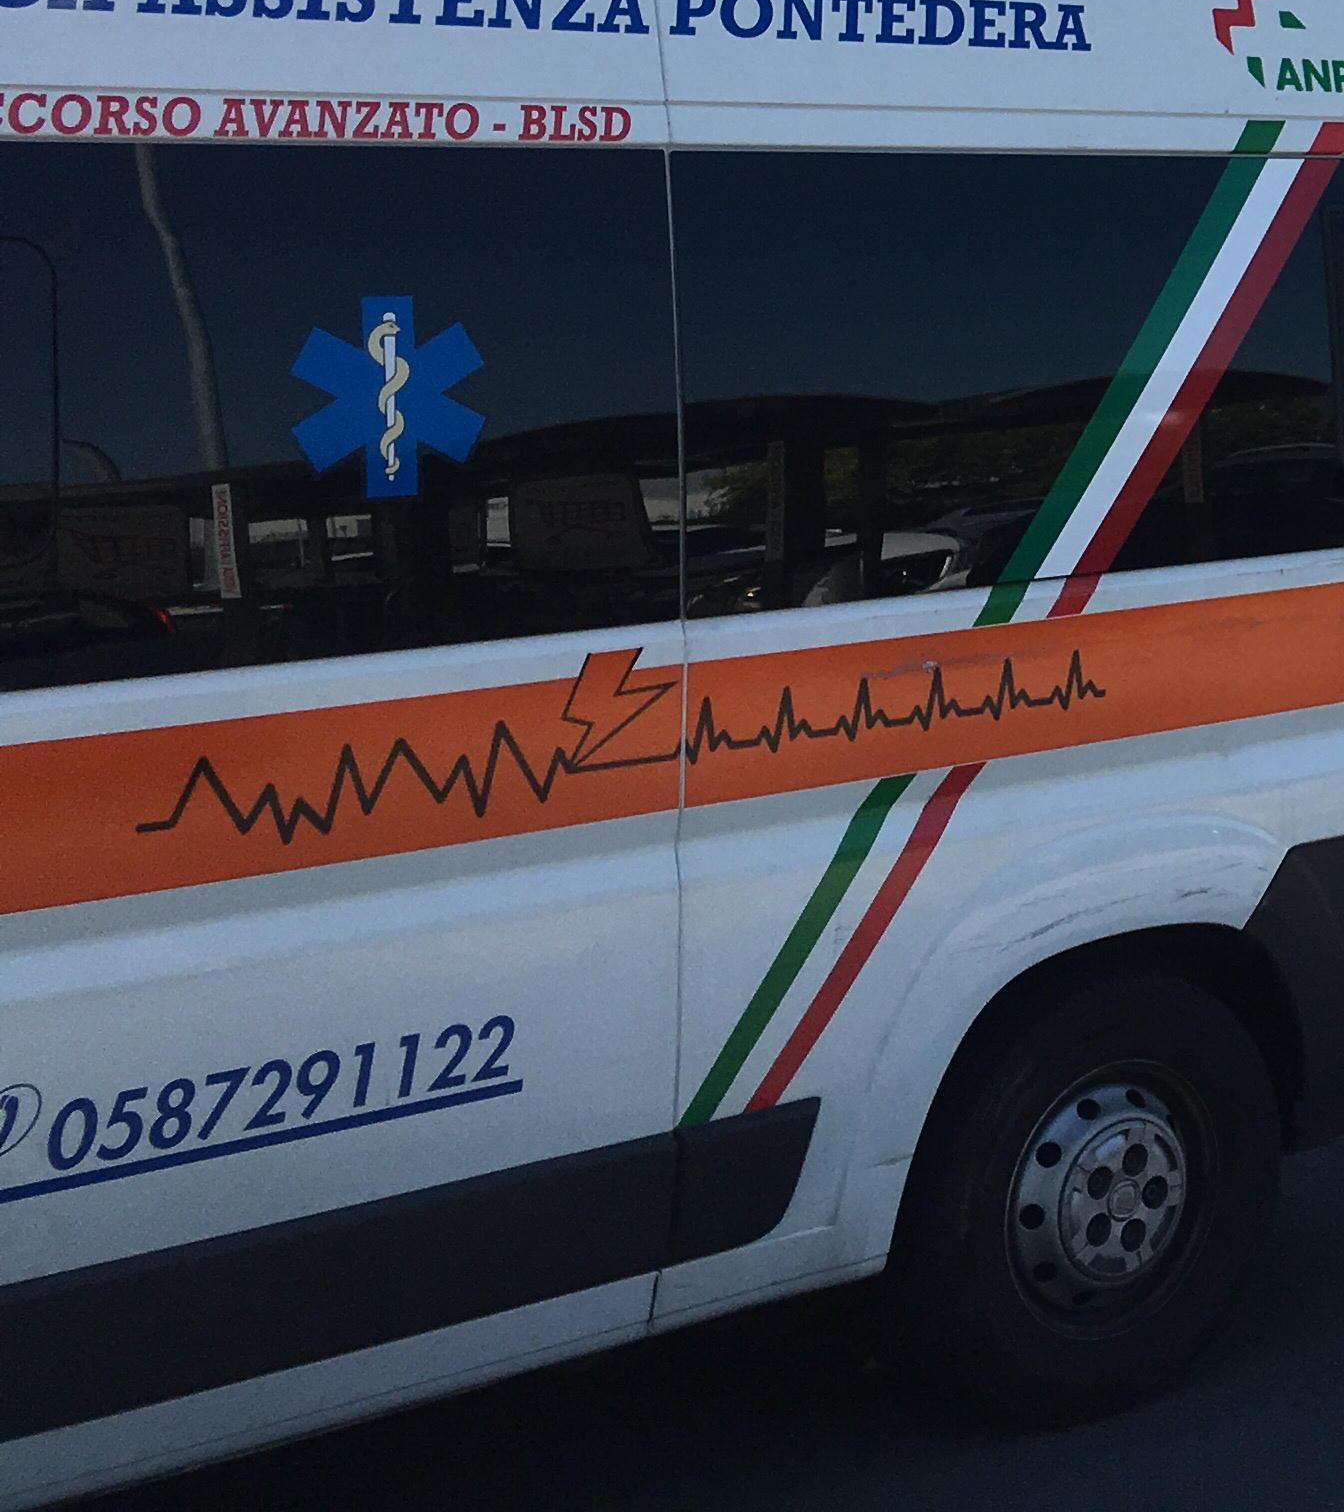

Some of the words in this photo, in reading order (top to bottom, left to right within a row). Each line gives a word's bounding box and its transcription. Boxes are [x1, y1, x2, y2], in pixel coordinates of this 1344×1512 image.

[0, 93, 201, 138] CORSO
[214, 98, 481, 141] AVANZATO
[518, 105, 632, 142] BLSD
[47, 1014, 515, 1171] 0587291122
